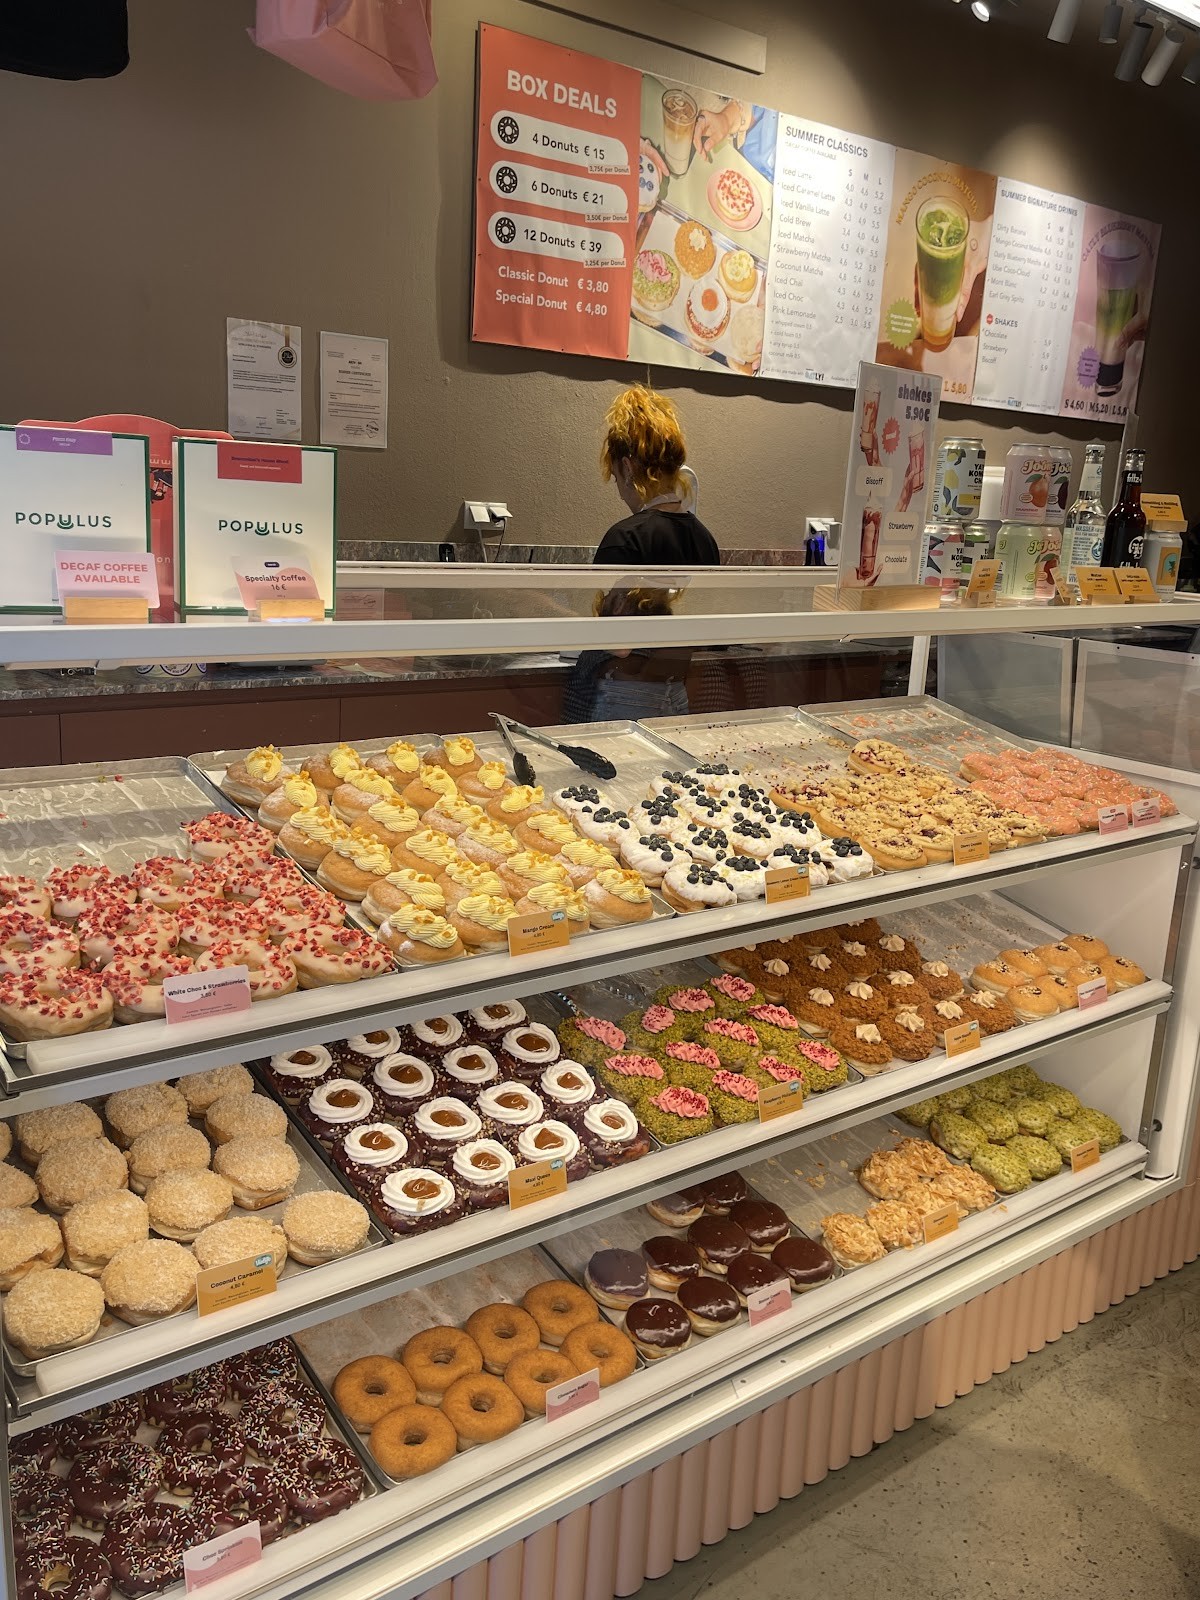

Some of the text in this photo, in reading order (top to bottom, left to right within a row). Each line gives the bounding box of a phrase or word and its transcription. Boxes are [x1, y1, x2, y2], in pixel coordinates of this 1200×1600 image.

[507, 70, 616, 118] BOX DEALS
[533, 133, 604, 160] 4 Donuts € 15
[786, 126, 824, 146] SUMMER
[827, 138, 868, 158] CLASSICS
[531, 181, 604, 205] 6 Donuts € 21
[782, 183, 795, 192] Iced
[796, 186, 819, 198] Caramel
[821, 192, 836, 202] Latte
[781, 199, 793, 209] Iced
[795, 201, 814, 213] Vanilla
[816, 206, 830, 216] Latte
[1001, 190, 1078, 216] SUMMER SIGNATURE DRINKS
[779, 214, 811, 227] Cold Brew
[524, 229, 602, 253] 12 Donuts € 39
[778, 230, 791, 239] Iced
[793, 232, 815, 244] Matcha
[777, 245, 811, 260] Strawberry
[812, 251, 831, 262] Matcha
[776, 260, 823, 276] Coconut Matcha
[498, 265, 608, 294] Classic Donut € 3,80
[775, 276, 803, 288] Iced Chai
[496, 290, 607, 317] Special Donut € 4,80
[774, 291, 804, 303] Iced Choc
[772, 306, 786, 315] Pink
[787, 308, 816, 320] Lemonade
[995, 318, 1018, 327] SHAKES
[985, 330, 1007, 339] Chocolate
[983, 343, 1008, 354] Strawberry
[898, 384, 932, 403] shakes
[944, 381, 967, 394] L 5,80
[1065, 399, 1068, 408] S
[1070, 400, 1084, 410] 4,60
[1089, 402, 1095, 411] M
[1096, 404, 1108, 414] 5,20
[1112, 405, 1115, 414] L
[866, 477, 884, 486] Biscoff
[16, 512, 112, 530] POPULUS
[219, 520, 303, 536] POPULUS
[888, 522, 914, 532] Strawberry
[61, 562, 148, 572] DECAF COFFEE
[75, 574, 140, 584] AVAILABLE
[208, 978, 246, 989] Strawberries
[210, 1268, 264, 1289] Coconut Caramel
[203, 1552, 217, 1561] Choc
